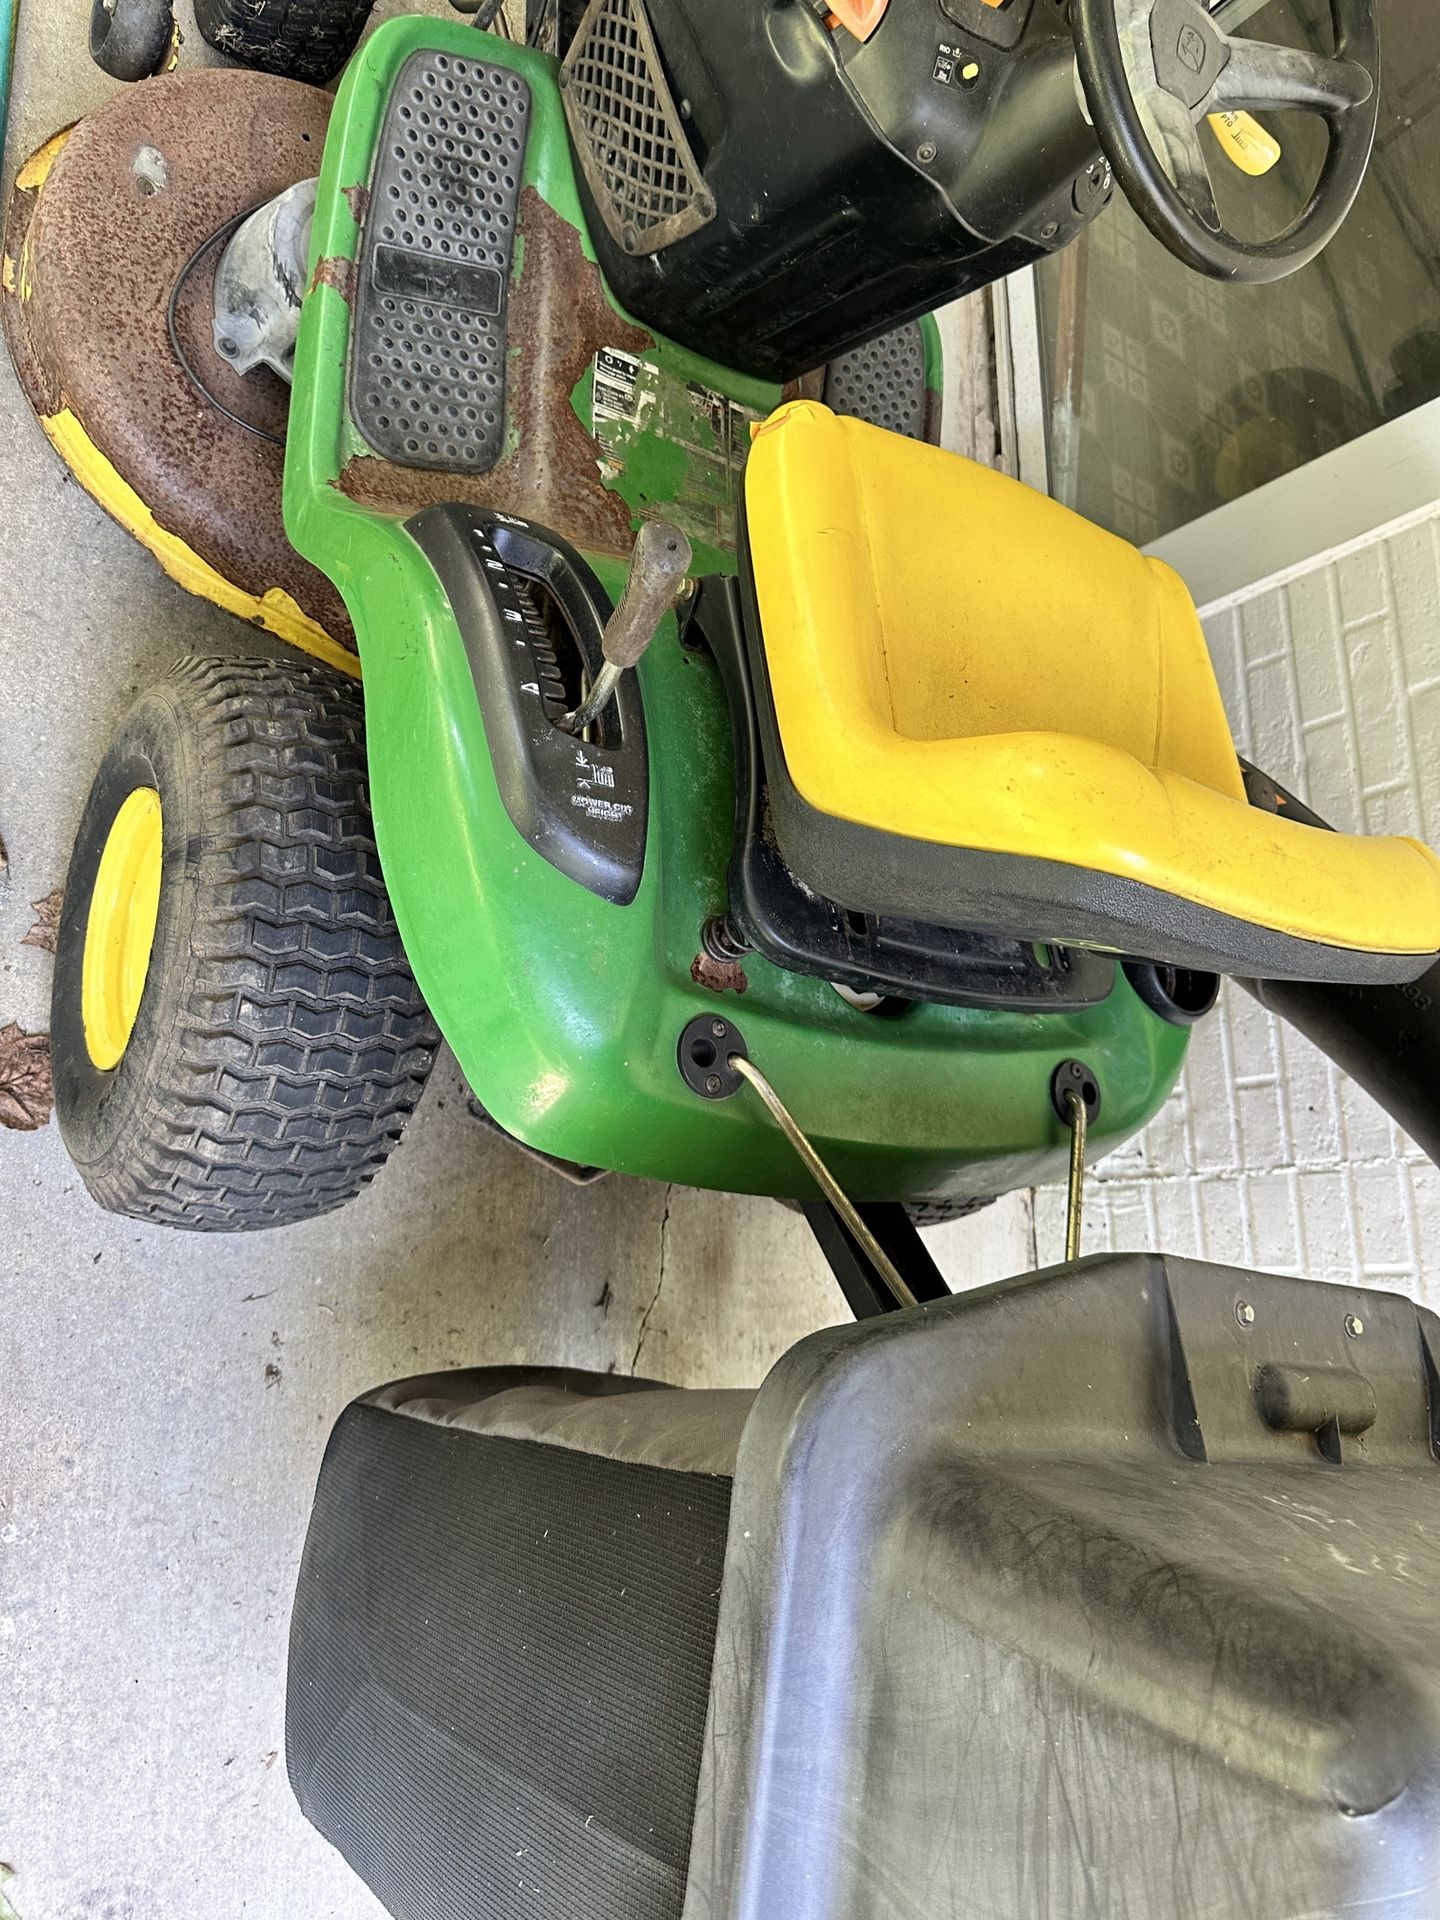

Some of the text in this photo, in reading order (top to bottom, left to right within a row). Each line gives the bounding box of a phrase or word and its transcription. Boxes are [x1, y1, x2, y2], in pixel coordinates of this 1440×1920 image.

[1220, 113, 1234, 128] PTO
[485, 558, 506, 572] 2
[503, 607, 523, 622] 3
[520, 681, 540, 695] 4
[570, 794, 634, 816] MOWER CUT
[585, 805, 624, 822] HEIGHT
